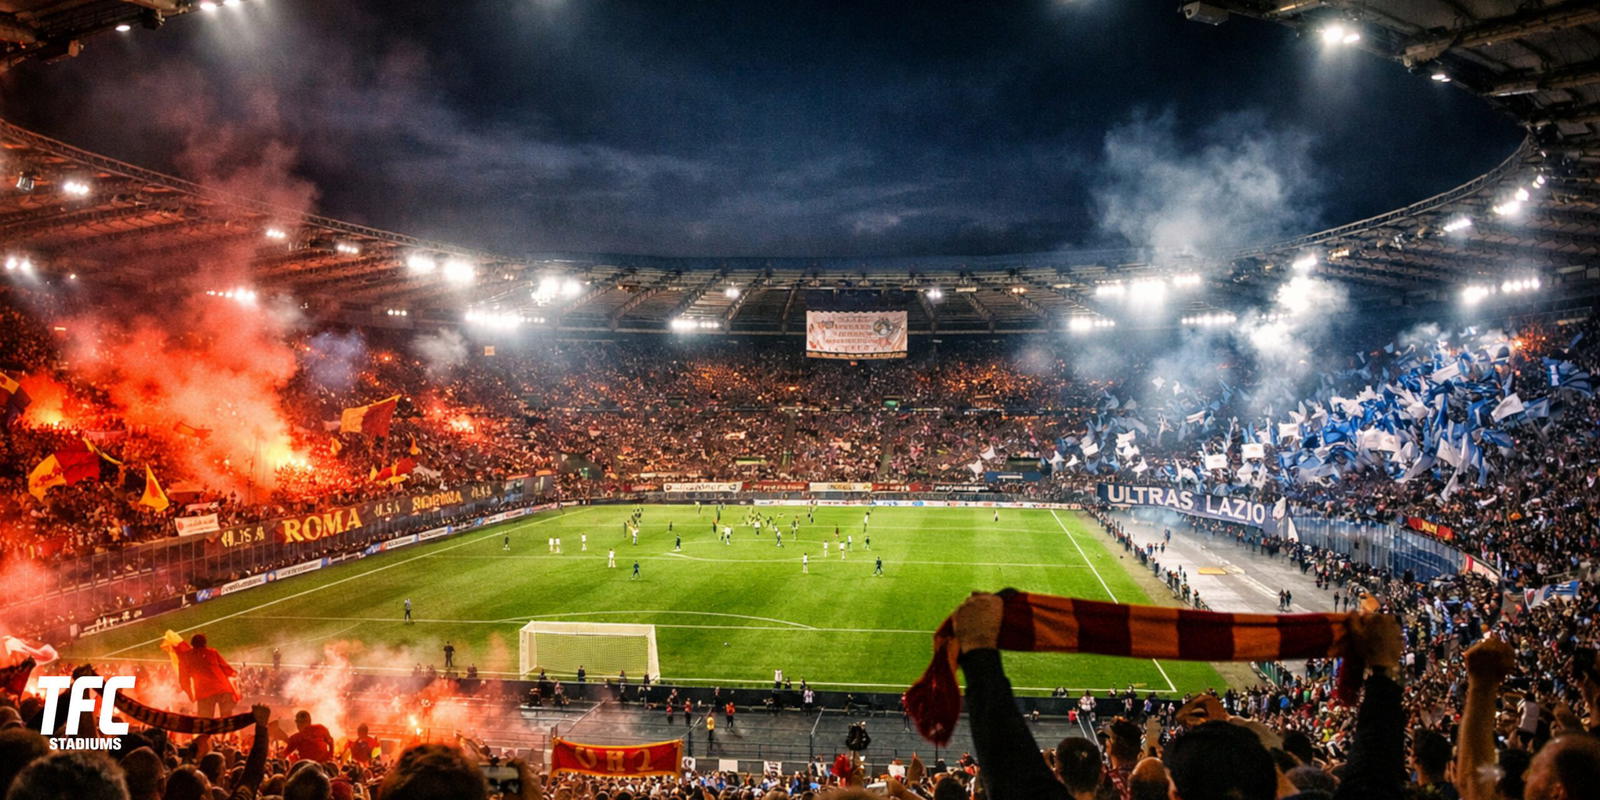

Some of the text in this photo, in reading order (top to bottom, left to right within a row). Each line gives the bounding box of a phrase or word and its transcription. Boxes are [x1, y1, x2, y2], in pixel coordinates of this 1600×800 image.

[1107, 485, 1265, 525] ULTRAS LAZIO
[282, 507, 363, 544] ROMA
